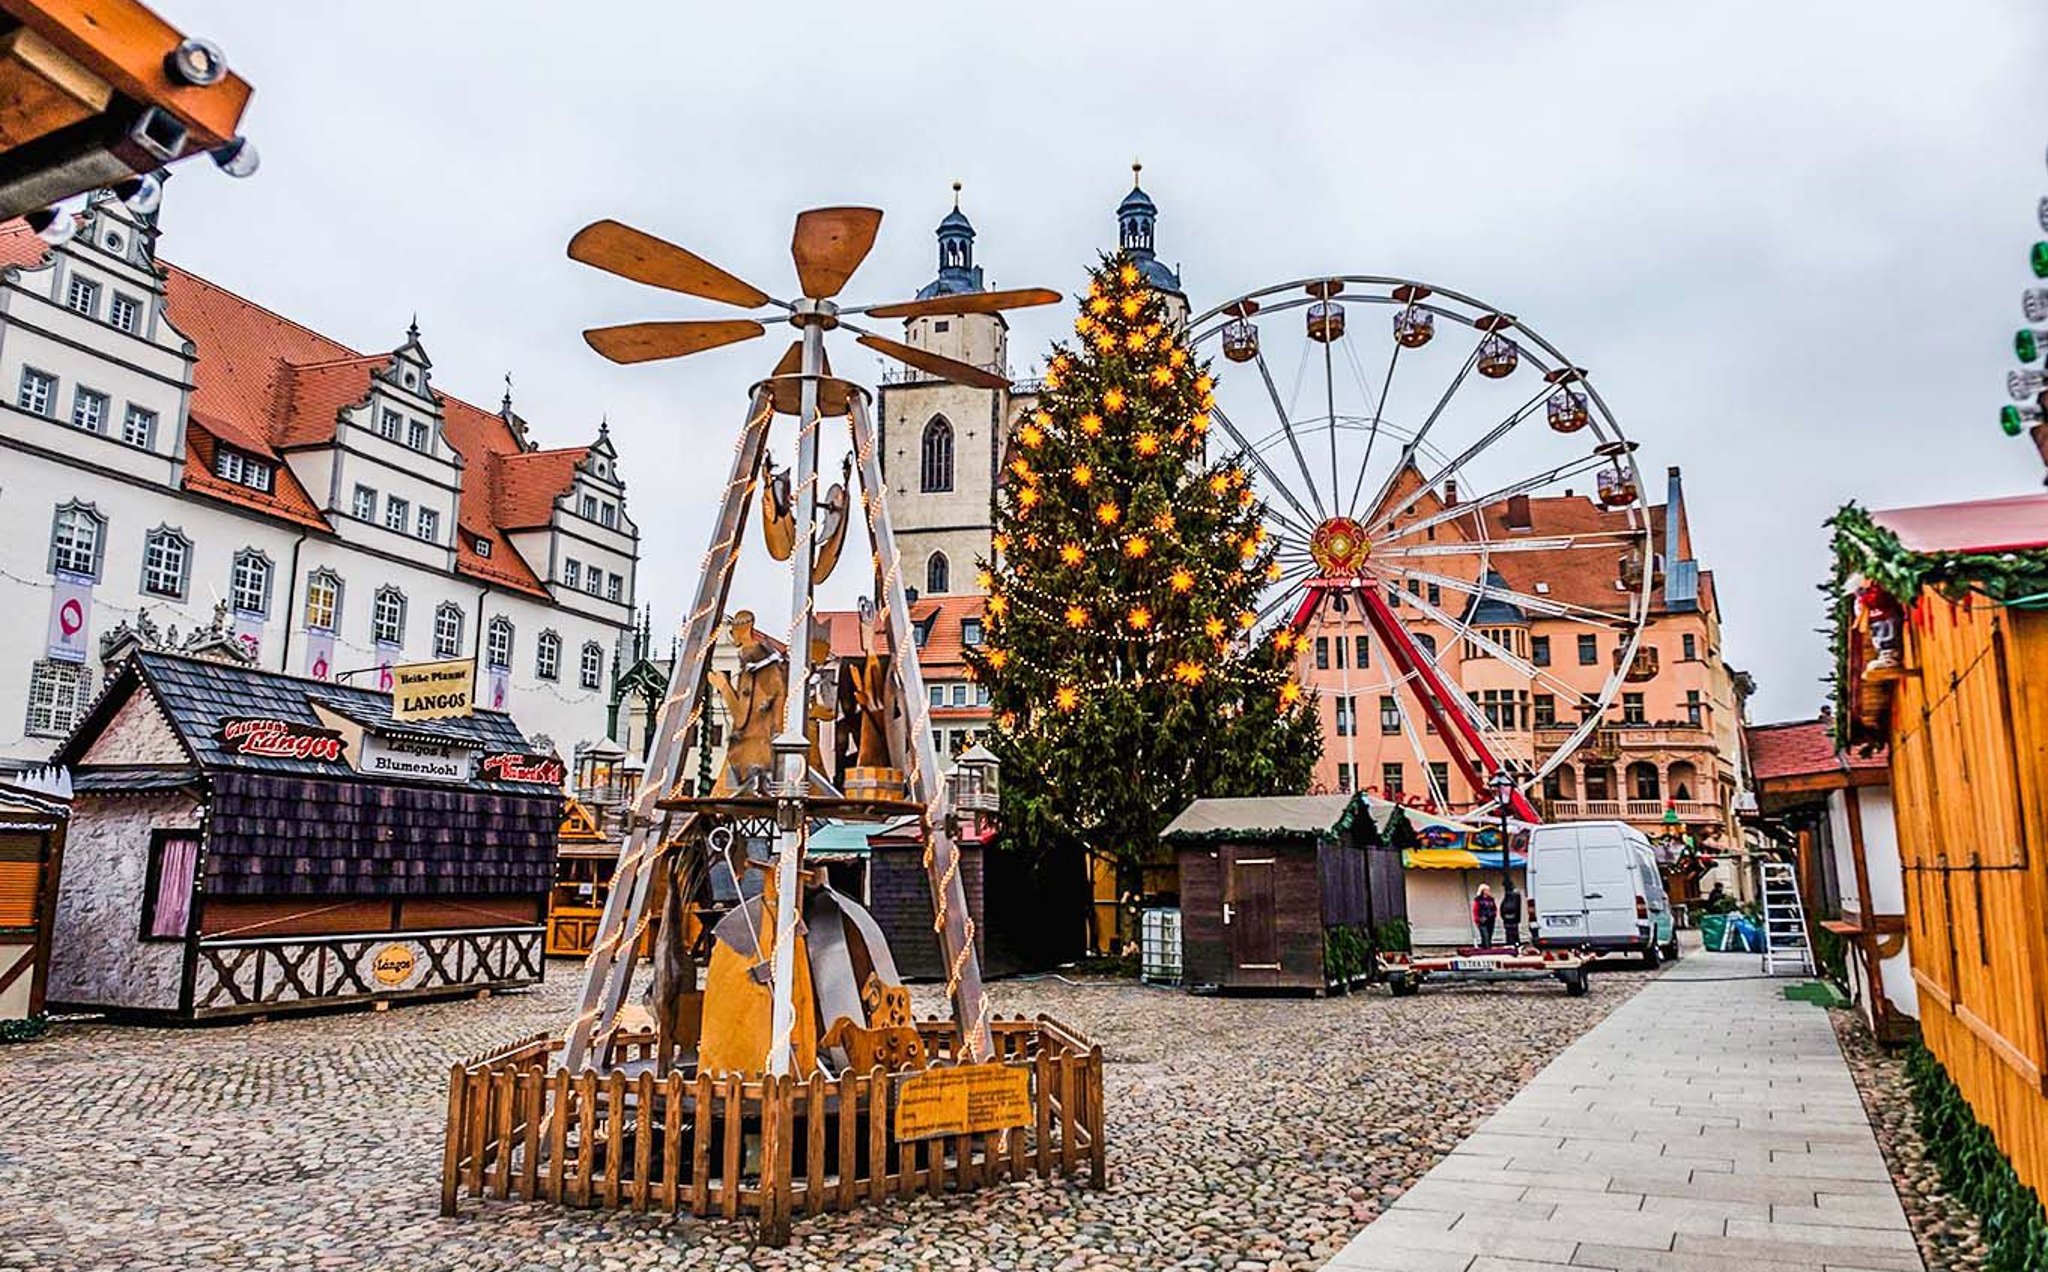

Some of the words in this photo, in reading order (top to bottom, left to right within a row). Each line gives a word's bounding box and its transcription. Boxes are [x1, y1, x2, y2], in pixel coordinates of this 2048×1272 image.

[402, 692, 466, 712] LANGOS
[440, 745, 451, 760] &
[374, 757, 458, 776] Blumenkohl
